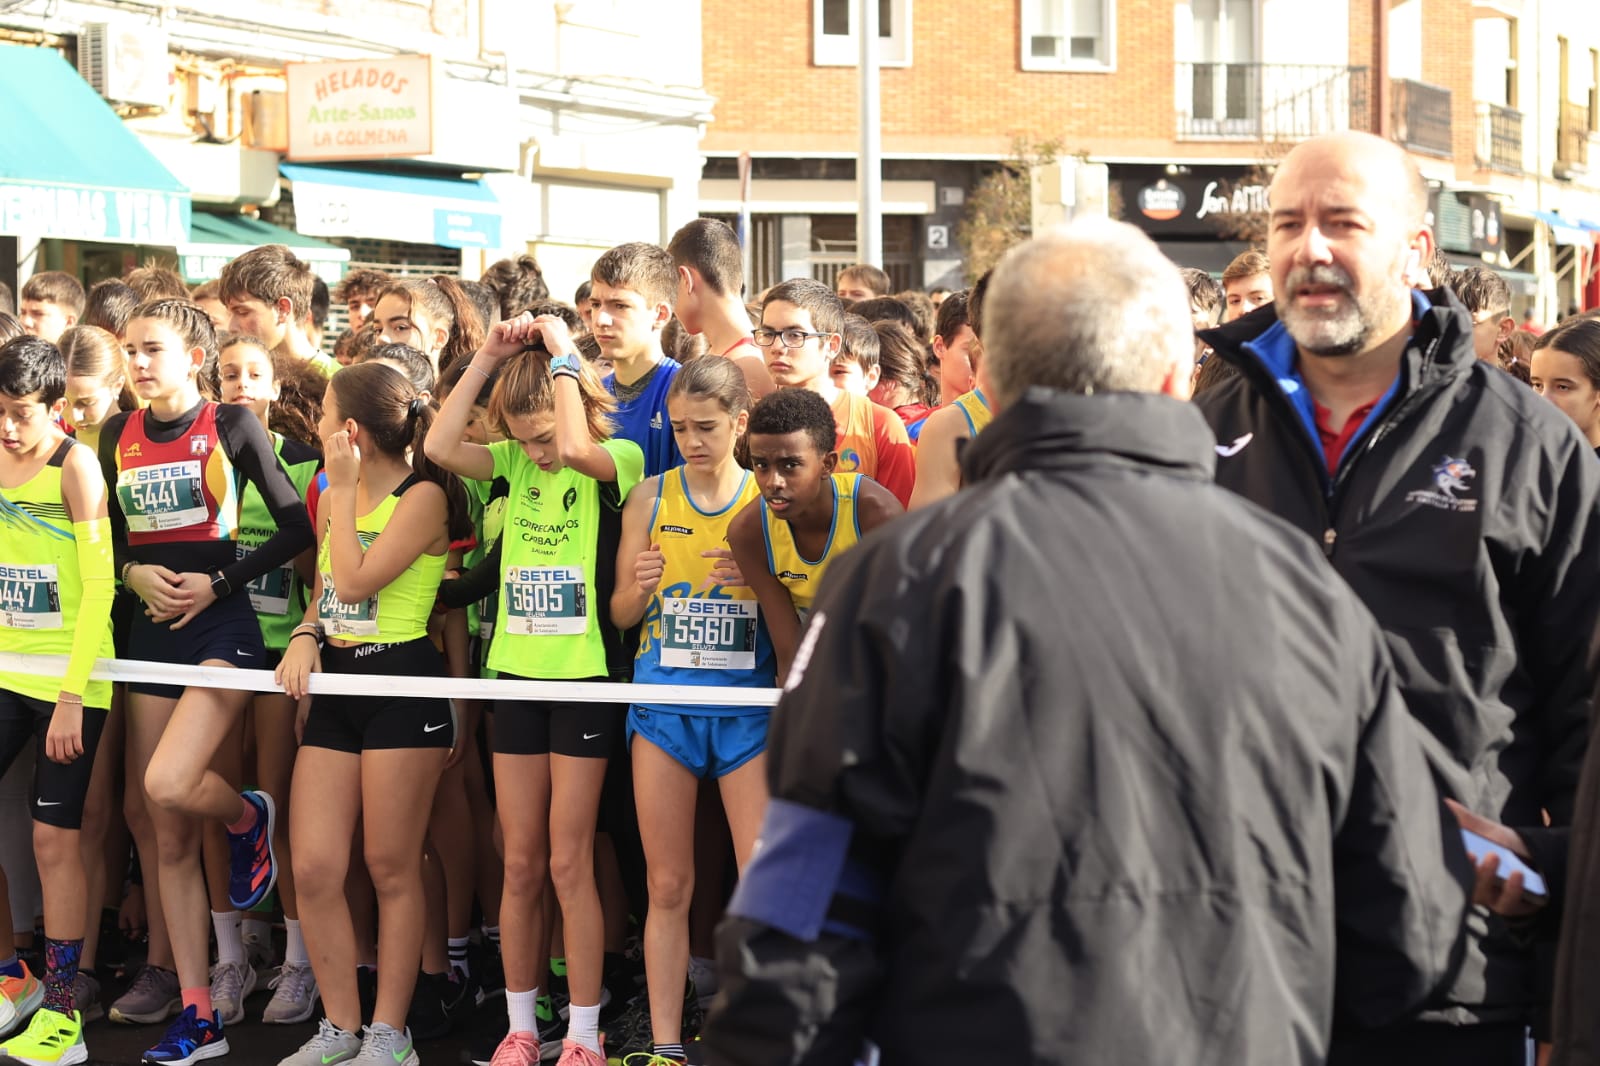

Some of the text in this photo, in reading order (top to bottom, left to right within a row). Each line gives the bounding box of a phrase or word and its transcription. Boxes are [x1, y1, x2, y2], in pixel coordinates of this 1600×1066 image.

[315, 67, 409, 101] HELADOS
[307, 103, 417, 124] Arte-Sanos
[313, 127, 408, 147] LA COLMENA
[932, 228, 944, 245] 2
[137, 465, 191, 481] SETEL
[130, 480, 179, 511] 5441
[0, 566, 48, 579] SETEL
[519, 570, 577, 581] SETEL
[0, 580, 36, 608] 447
[512, 583, 563, 612] 5605
[689, 602, 749, 615] SETEL
[674, 615, 735, 645] 5560
[354, 643, 386, 658] NIKE
